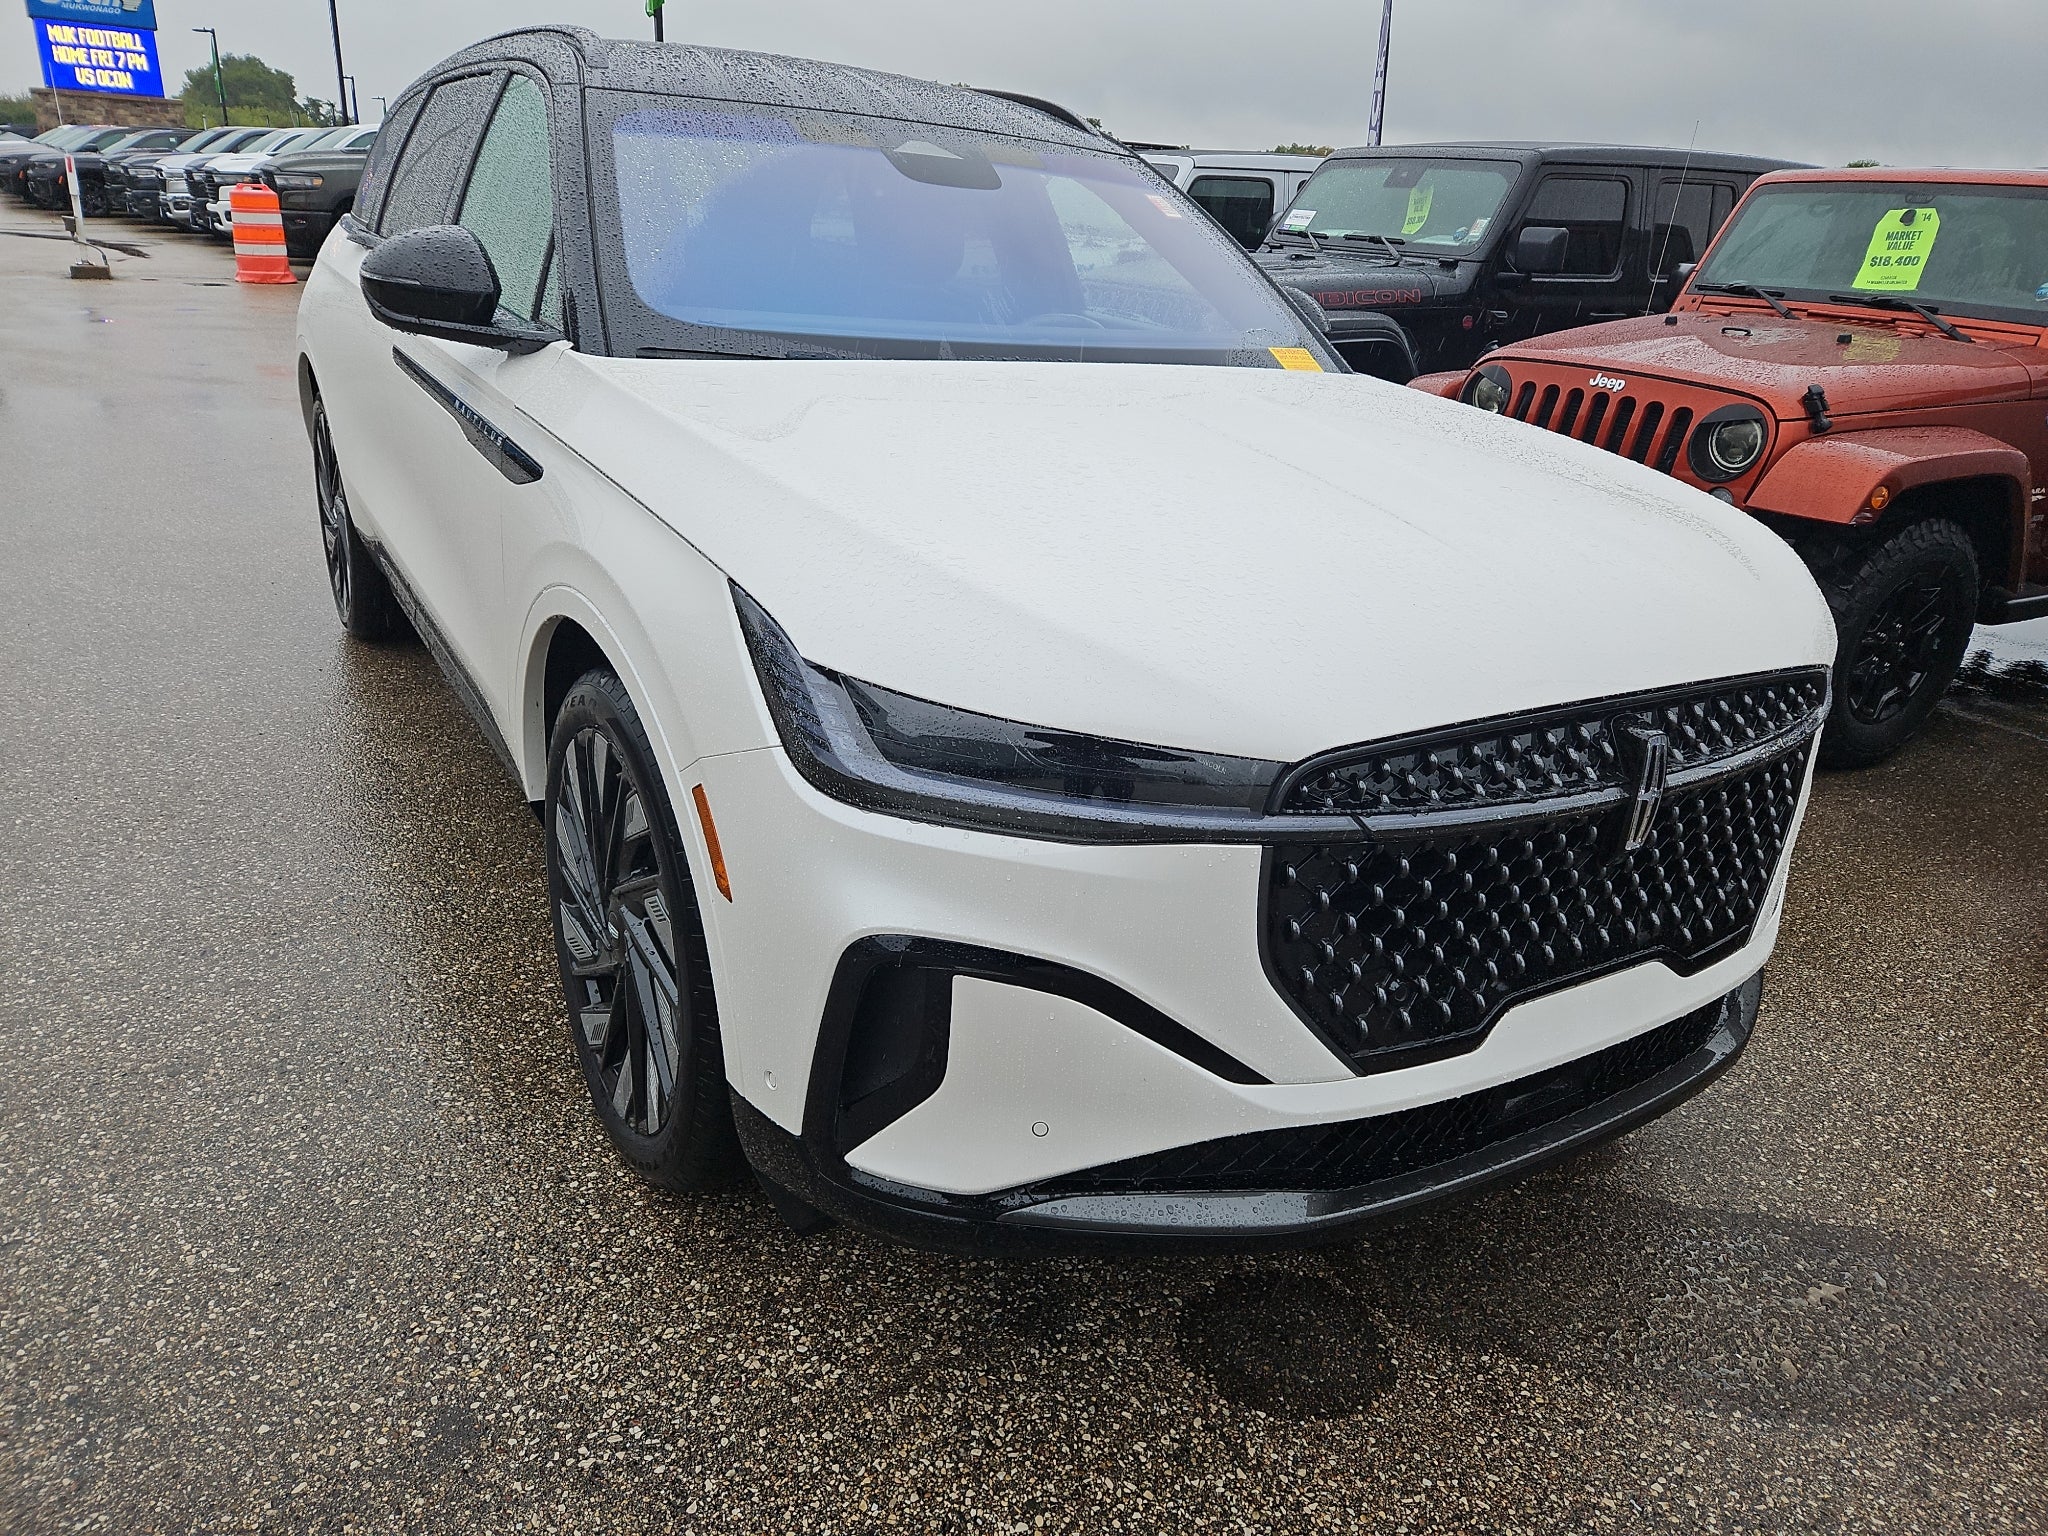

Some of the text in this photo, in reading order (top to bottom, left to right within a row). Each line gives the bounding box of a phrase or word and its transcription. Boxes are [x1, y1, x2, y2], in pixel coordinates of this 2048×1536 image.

[61, 2, 121, 14] MUKWONAGO
[46, 24, 145, 51] MUK FOOTBALL
[51, 45, 149, 71] HOME FRI 7 PM
[95, 69, 134, 89] OCON
[1885, 230, 1923, 241] MARKET
[1886, 241, 1914, 250] VALUE
[1312, 289, 1421, 305] BICON
[1589, 372, 1626, 393] Jeep
[454, 399, 502, 447] NAUTILUS
